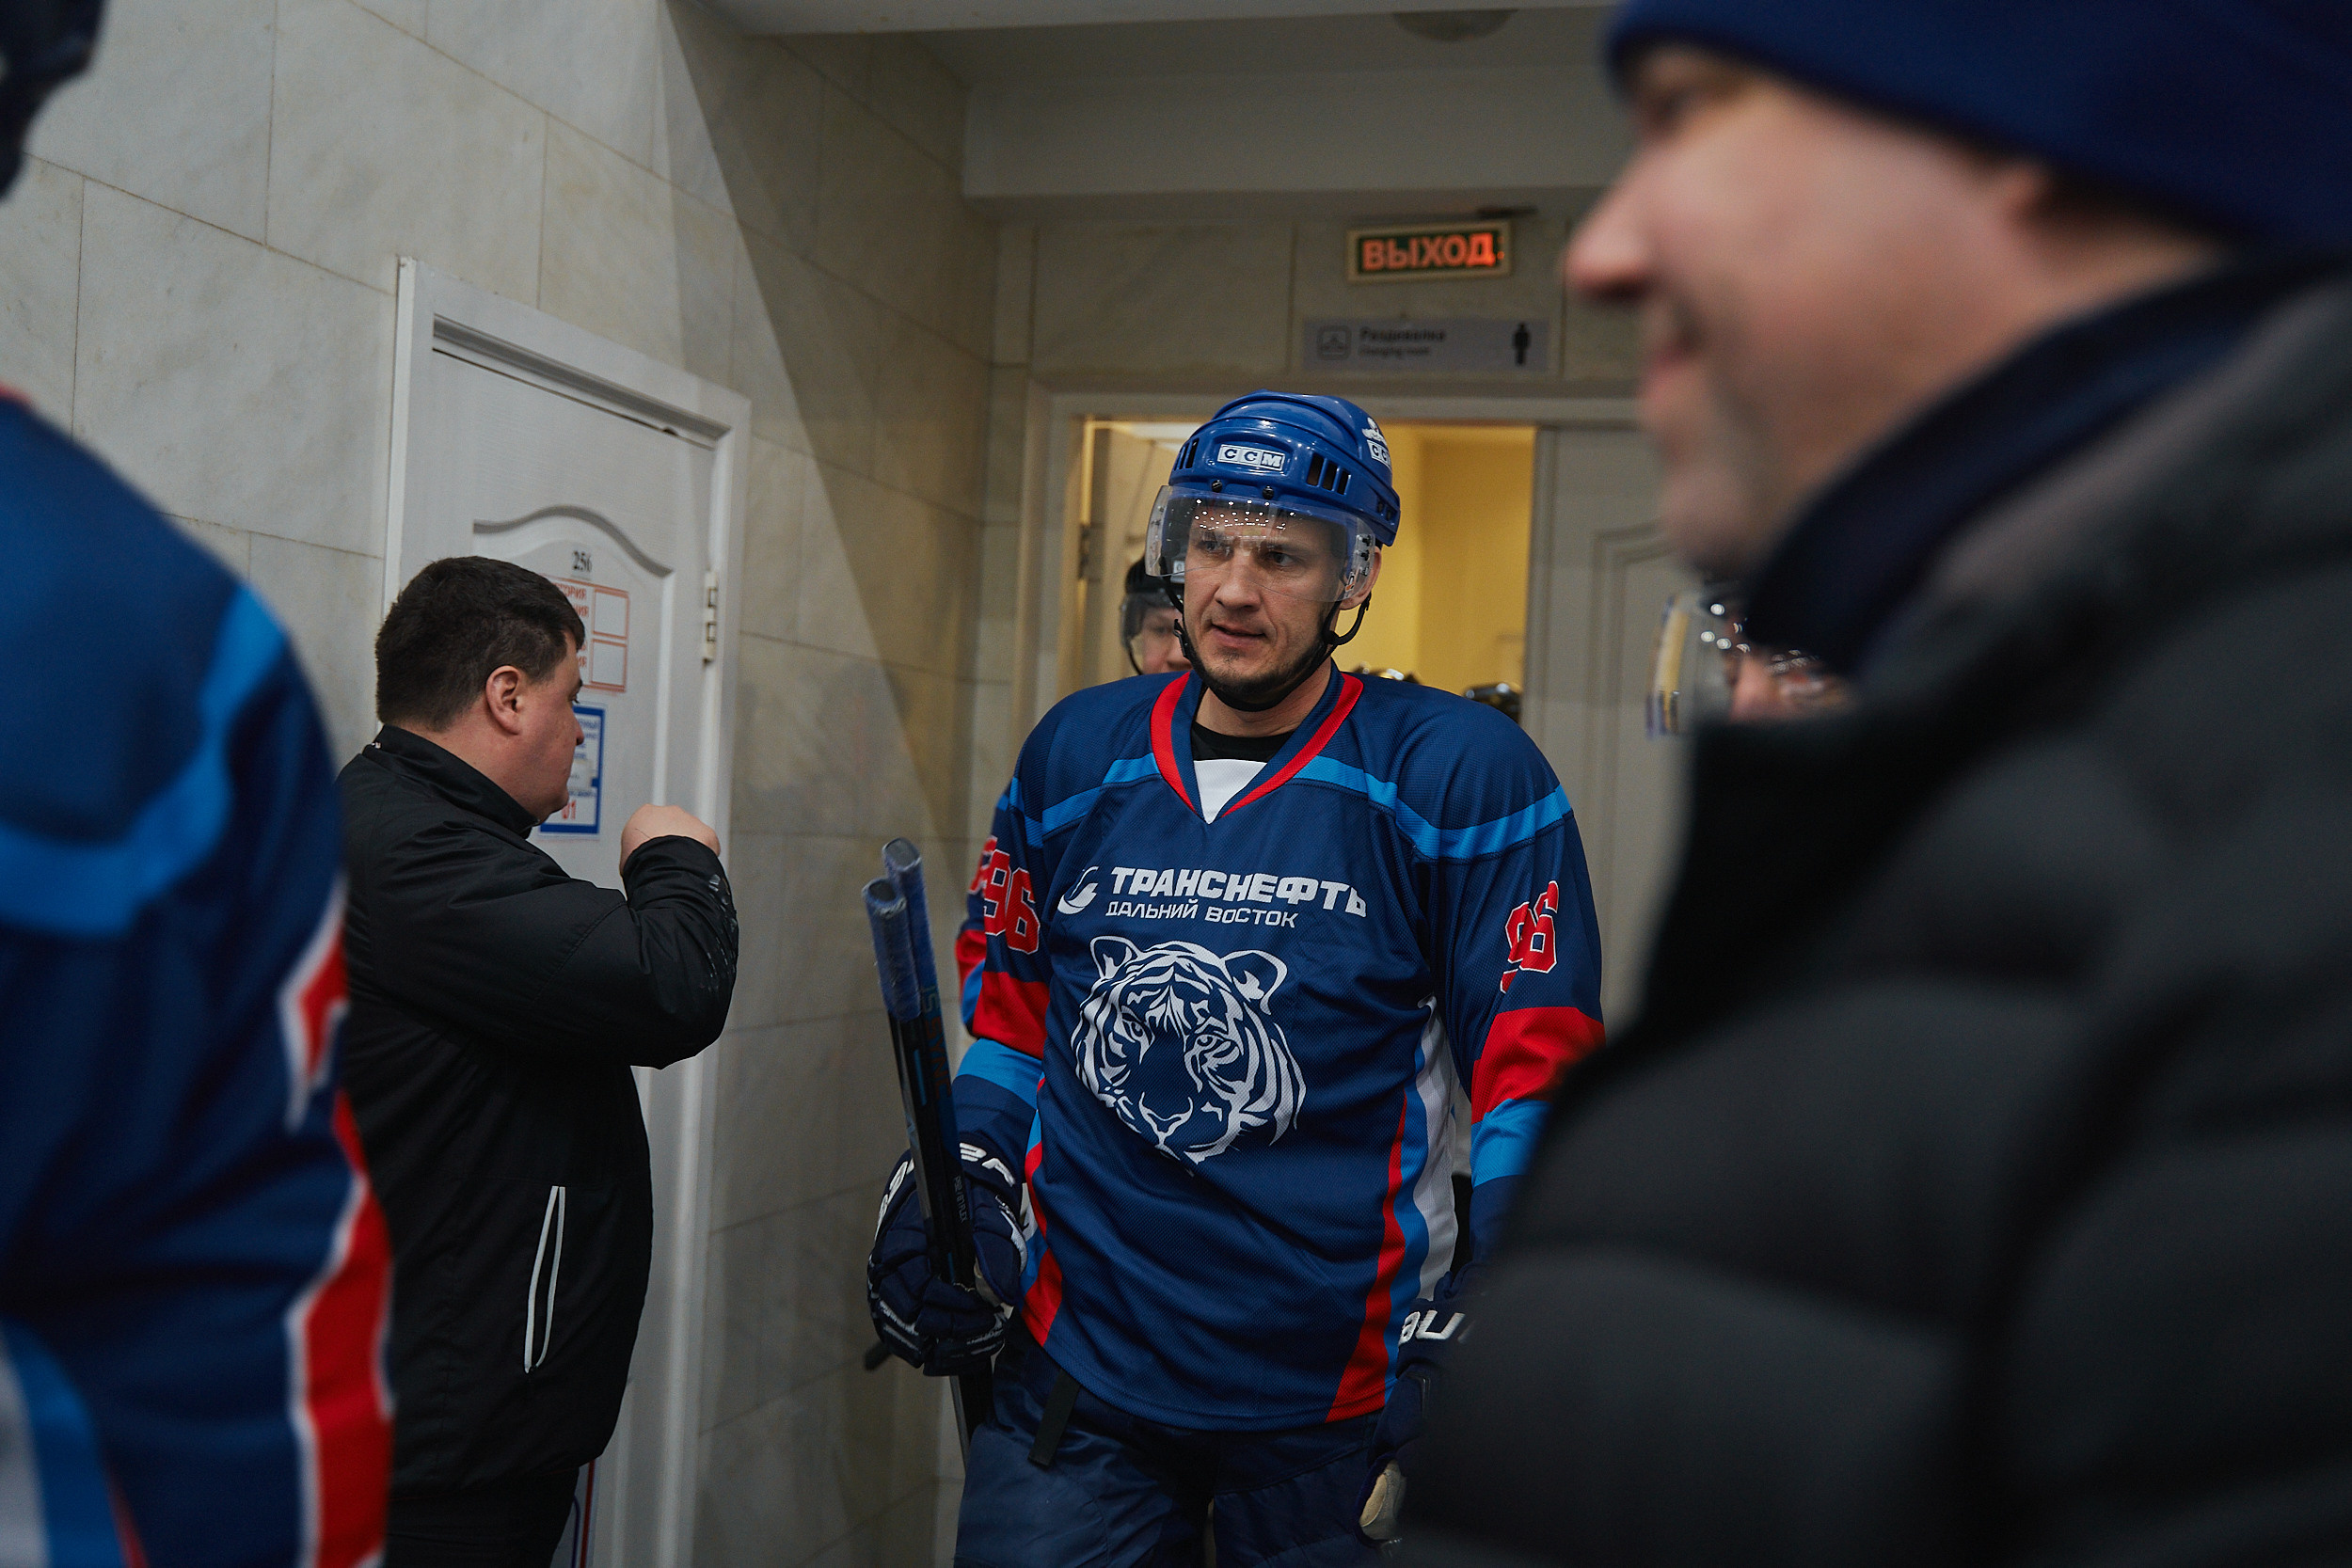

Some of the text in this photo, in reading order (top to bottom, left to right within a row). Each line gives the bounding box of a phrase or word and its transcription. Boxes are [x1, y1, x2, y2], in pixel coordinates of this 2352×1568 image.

[1362, 231, 1497, 271] ВЫХОД
[1221, 446, 1283, 469] CCM
[982, 848, 1041, 956] 96
[1110, 866, 1368, 918] ТРАНСНЕФТЬ
[1104, 898, 1299, 928] ДАЛЬНИЙ ВОСТОК
